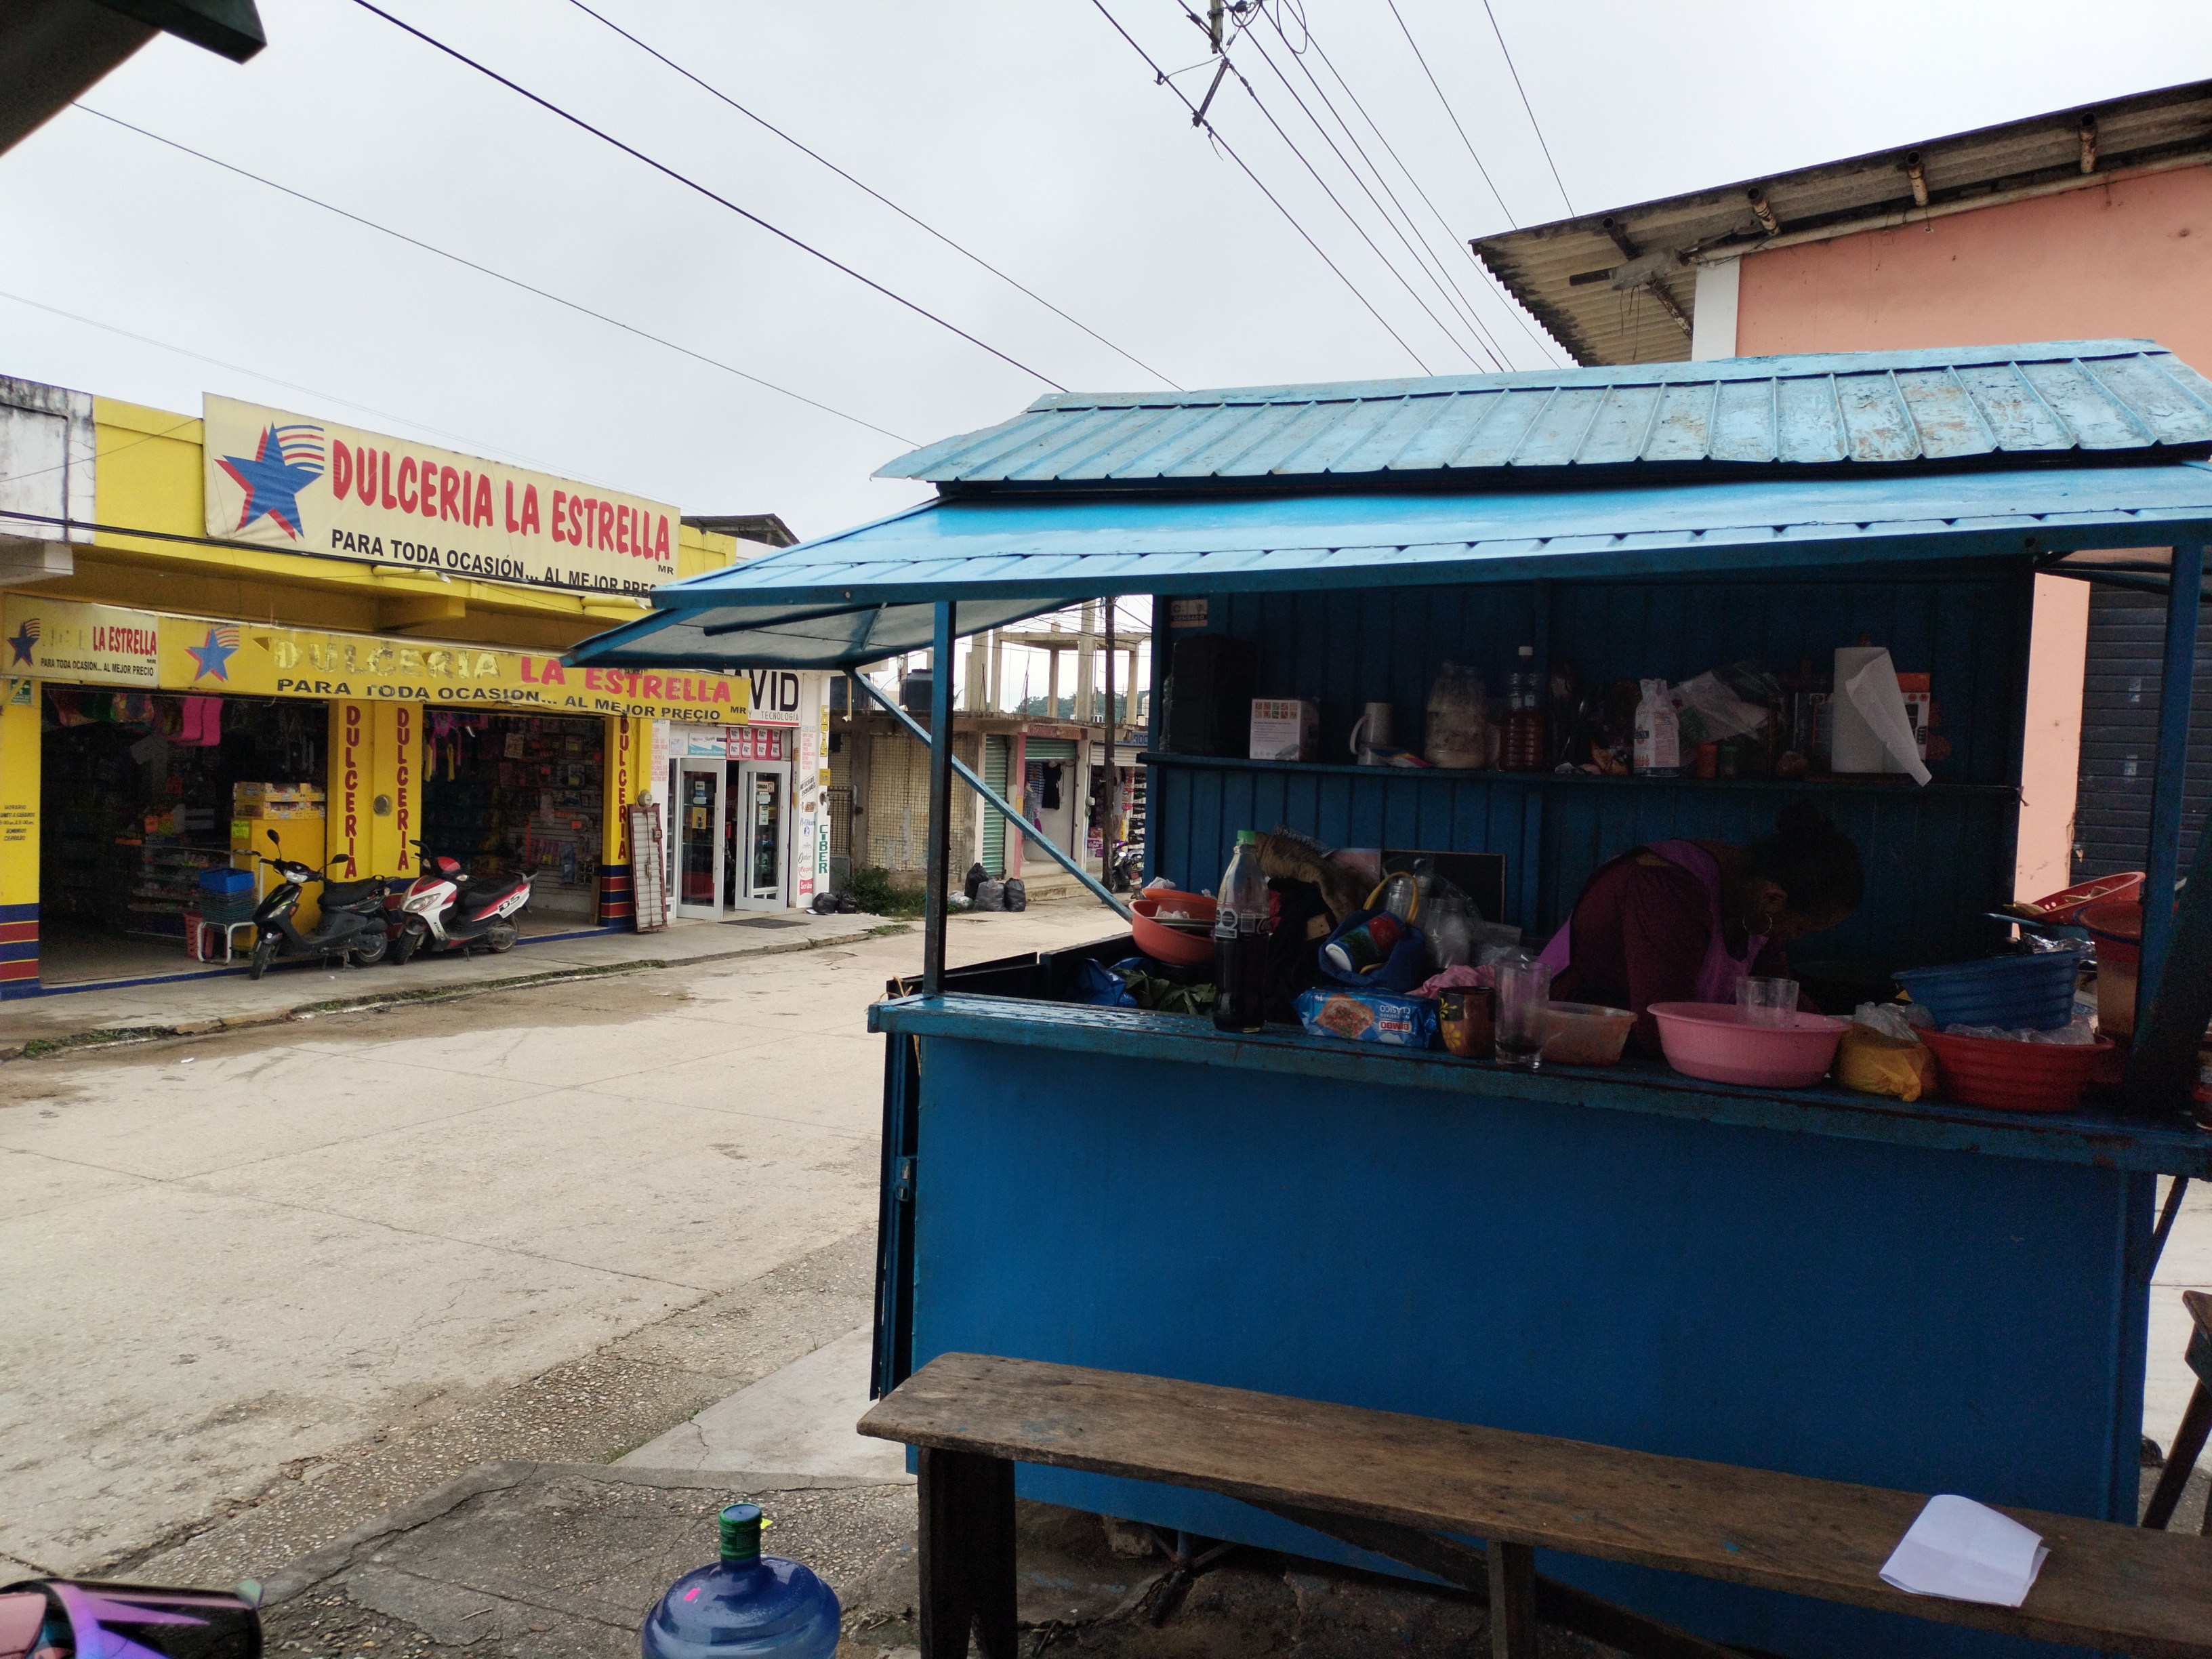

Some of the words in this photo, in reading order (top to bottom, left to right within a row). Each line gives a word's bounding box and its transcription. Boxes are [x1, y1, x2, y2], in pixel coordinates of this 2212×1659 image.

[333, 439, 493, 529] DULCERIA
[506, 479, 540, 536] LA
[552, 489, 670, 562] ESTRELLA
[332, 529, 384, 556] PARA
[390, 539, 441, 566] TODA
[544, 567, 563, 583] AL
[658, 565, 674, 575] MR
[93, 626, 106, 651] LA
[108, 626, 157, 656] ESTRELLA
[41, 658, 55, 668] PARA
[56, 659, 70, 669] TODA
[103, 663, 110, 672] AL
[112, 663, 131, 674] MEJOR
[133, 665, 154, 676] PRECIO
[522, 657, 566, 685] LA
[585, 668, 731, 703] ESTRELLA
[277, 678, 351, 695] PARA
[565, 695, 588, 708] AL
[595, 699, 655, 717] MEJOR
[661, 706, 720, 720] PRECIO
[731, 706, 746, 714] MR
[344, 705, 361, 879] DULCERIA
[397, 708, 409, 871] DULCERIA
[617, 718, 630, 860] DULCERIA
[819, 825, 828, 874] CIBER
[1380, 1022, 1409, 1031] BIMBO
